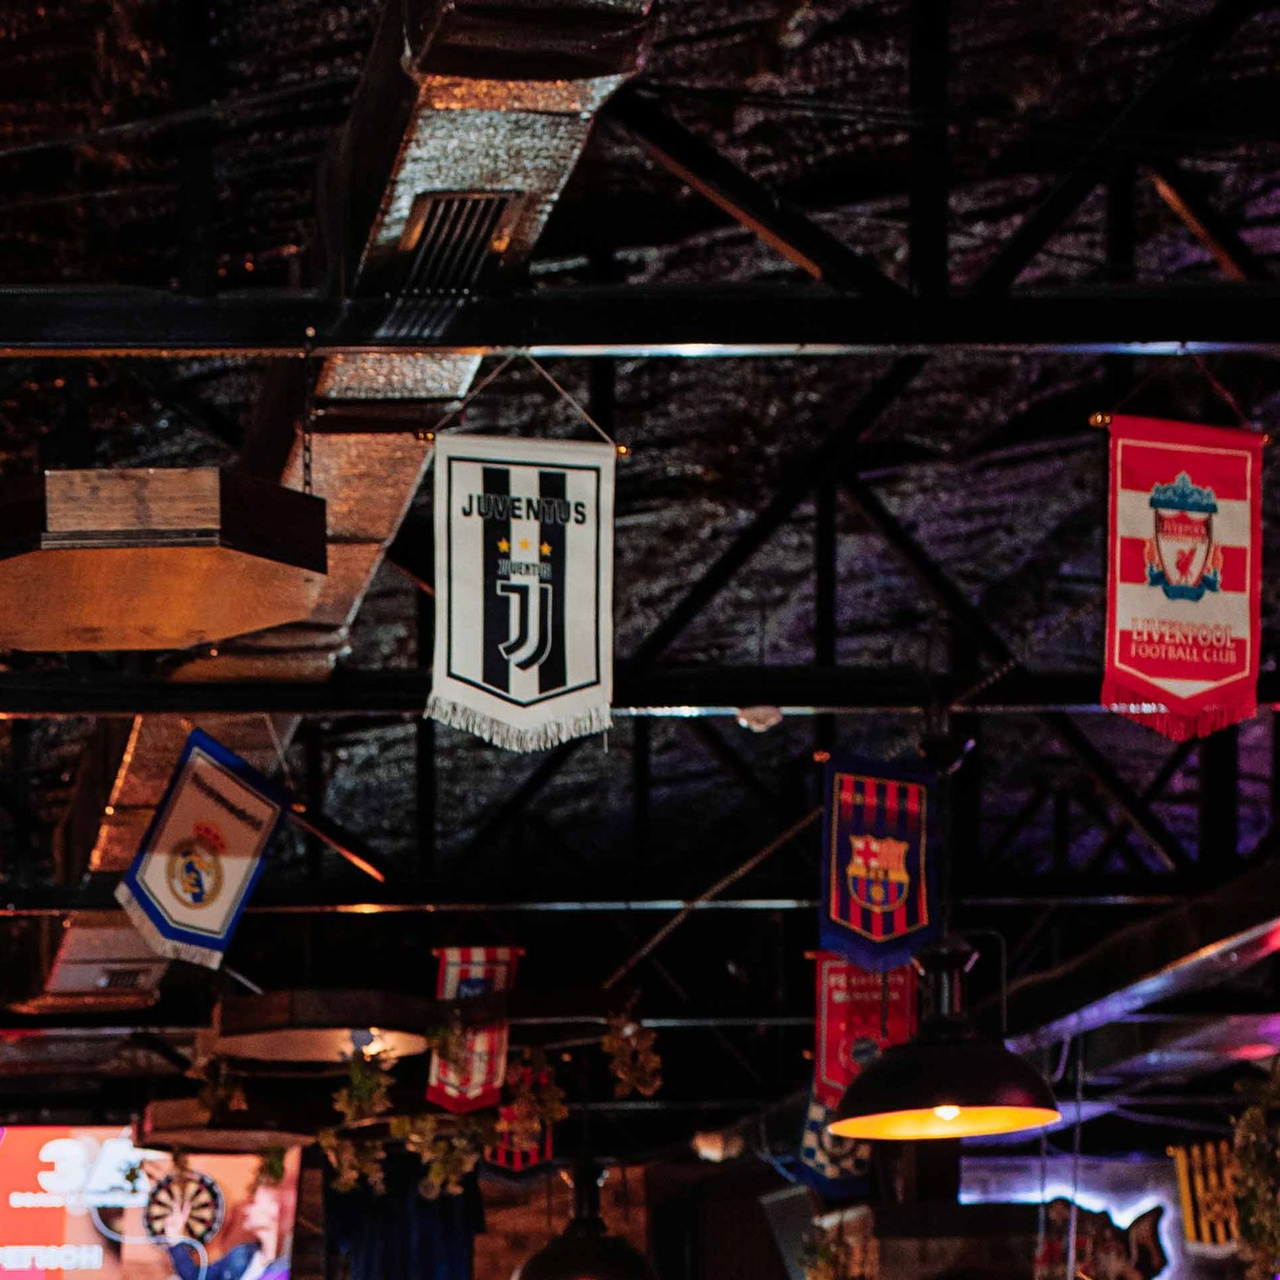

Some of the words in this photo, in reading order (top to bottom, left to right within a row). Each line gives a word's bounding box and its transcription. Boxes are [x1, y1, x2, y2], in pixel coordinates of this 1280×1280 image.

[461, 493, 587, 525] JUVENTUS
[497, 557, 553, 580] JUVENTUS
[1131, 617, 1236, 648] LIVERPOOL
[1130, 643, 1200, 663] FOOTBALL
[1202, 648, 1237, 664] CLUB
